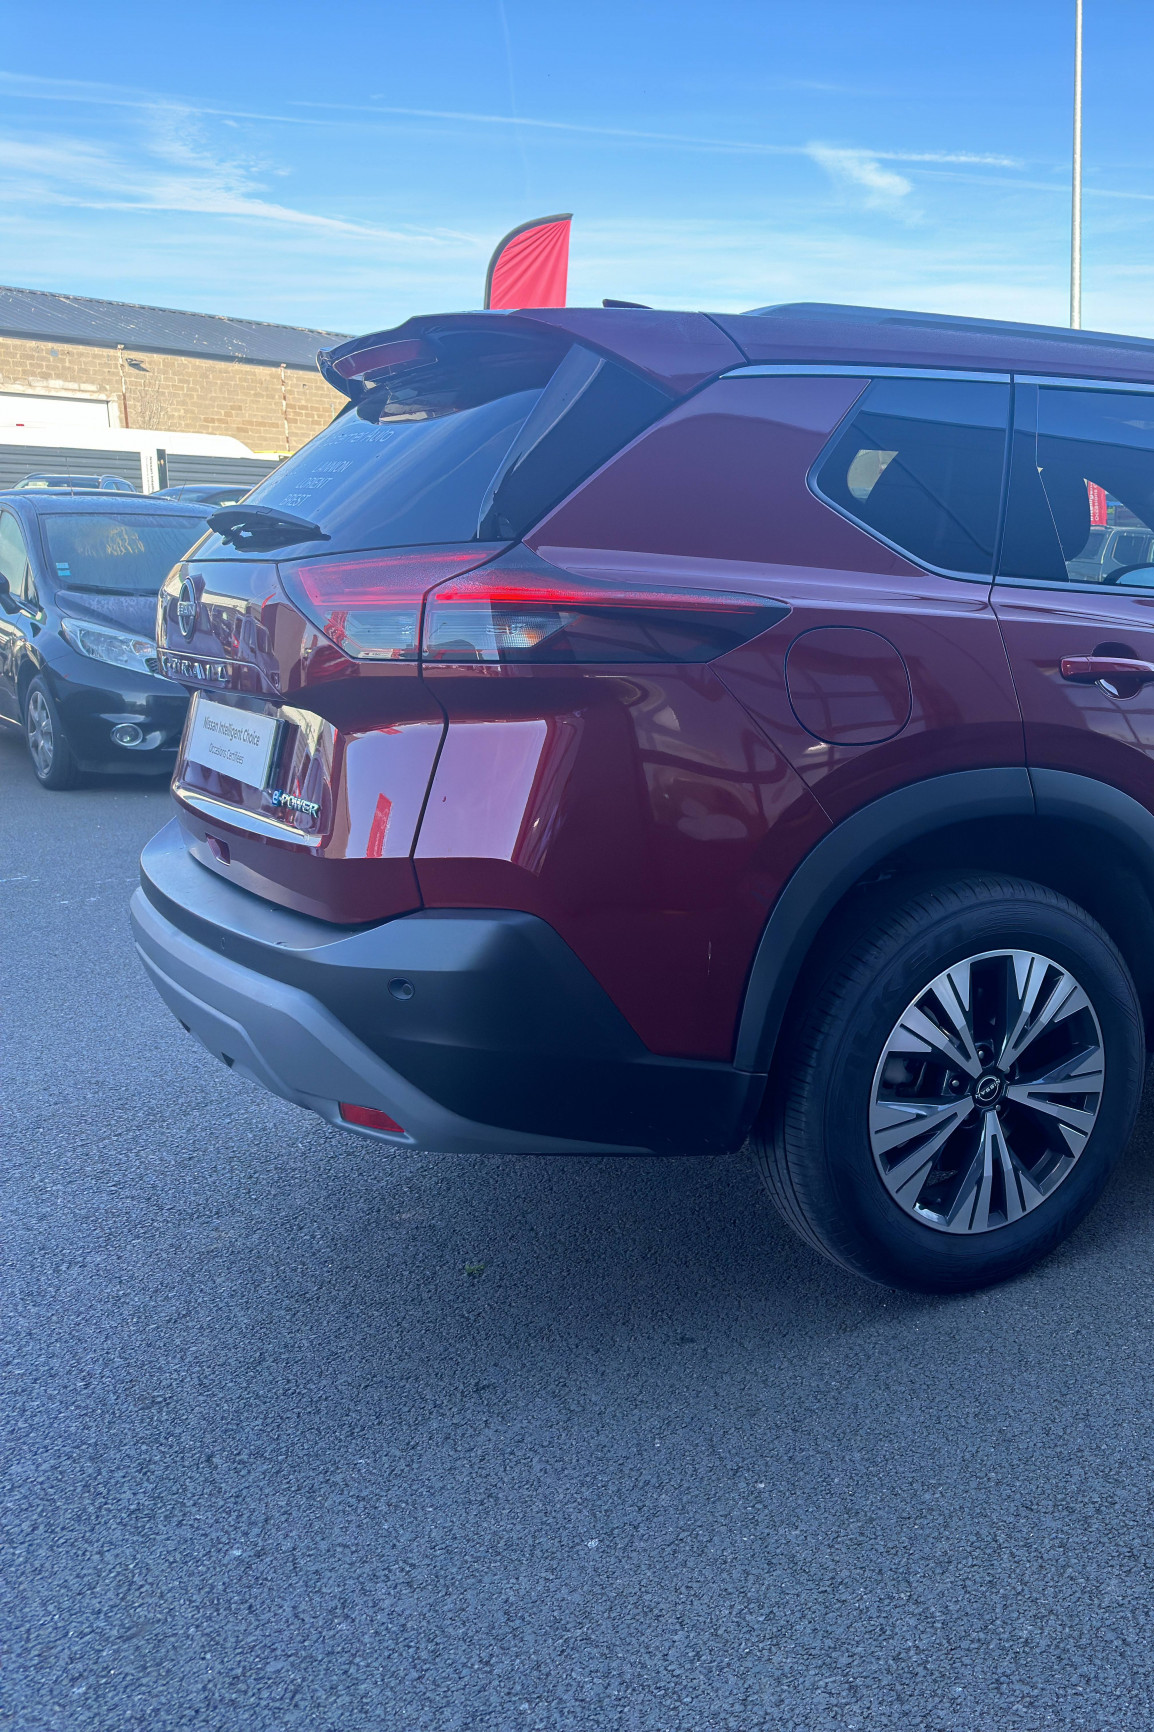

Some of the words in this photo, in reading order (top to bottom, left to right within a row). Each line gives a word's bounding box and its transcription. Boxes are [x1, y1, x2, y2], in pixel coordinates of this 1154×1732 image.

[203, 716, 219, 733] Nissan
[218, 721, 243, 742] Intelligent
[243, 728, 260, 747] Choice
[209, 742, 227, 759] Occasions
